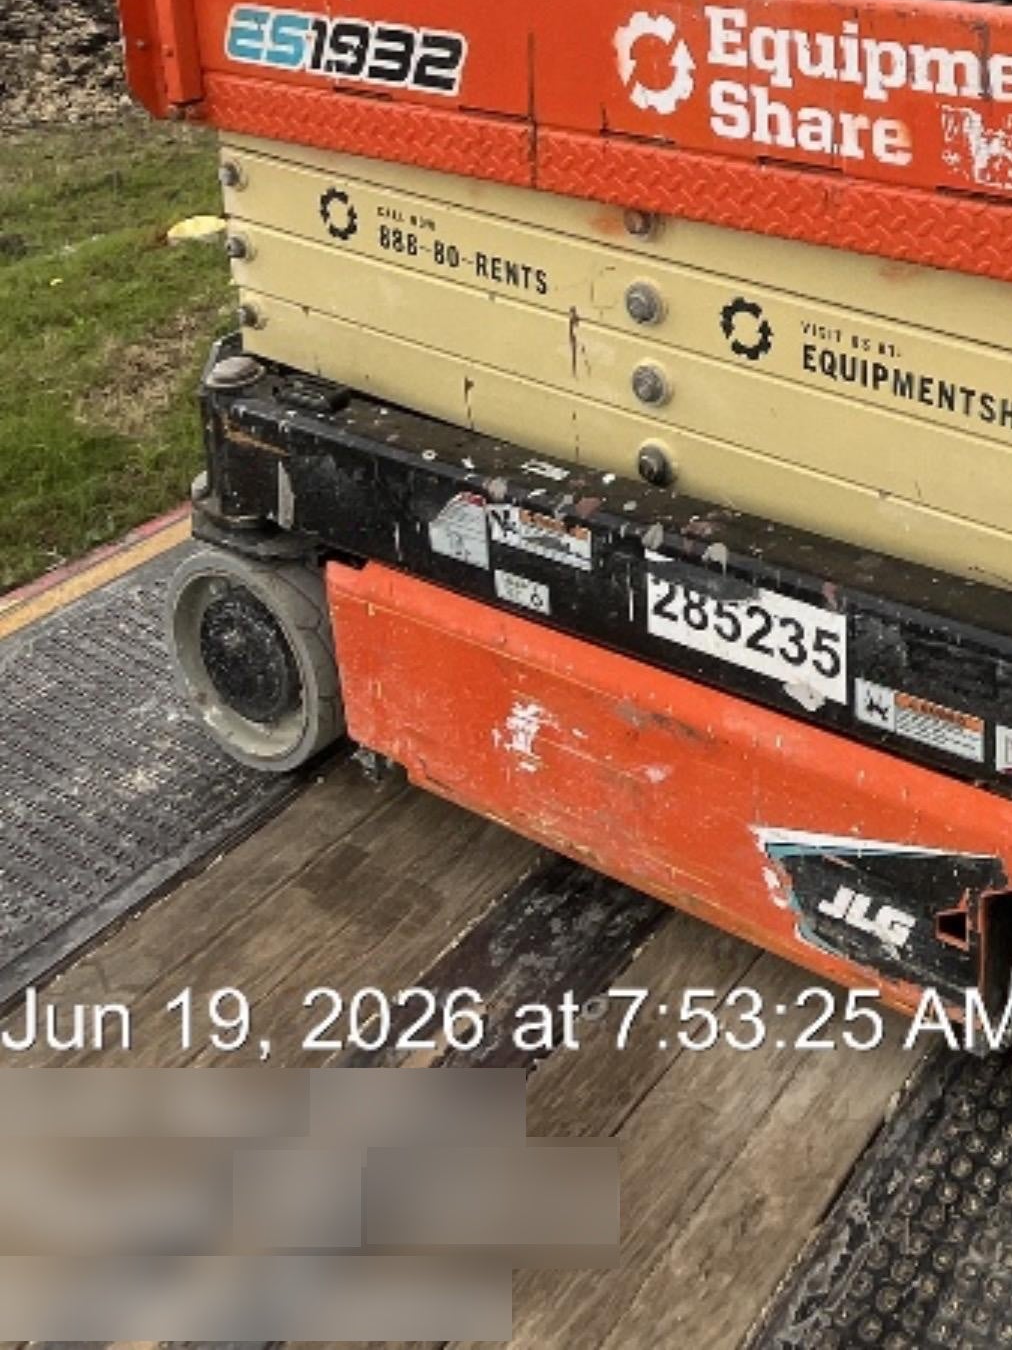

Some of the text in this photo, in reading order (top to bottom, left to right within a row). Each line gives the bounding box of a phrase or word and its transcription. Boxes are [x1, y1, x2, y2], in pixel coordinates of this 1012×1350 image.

[227, 7, 464, 91] ES1932
[708, 78, 914, 166] Share
[379, 224, 548, 295] 888-80-RENTS
[801, 320, 841, 342] VISIT
[652, 577, 843, 679] 285235
[818, 885, 916, 946] JLG
